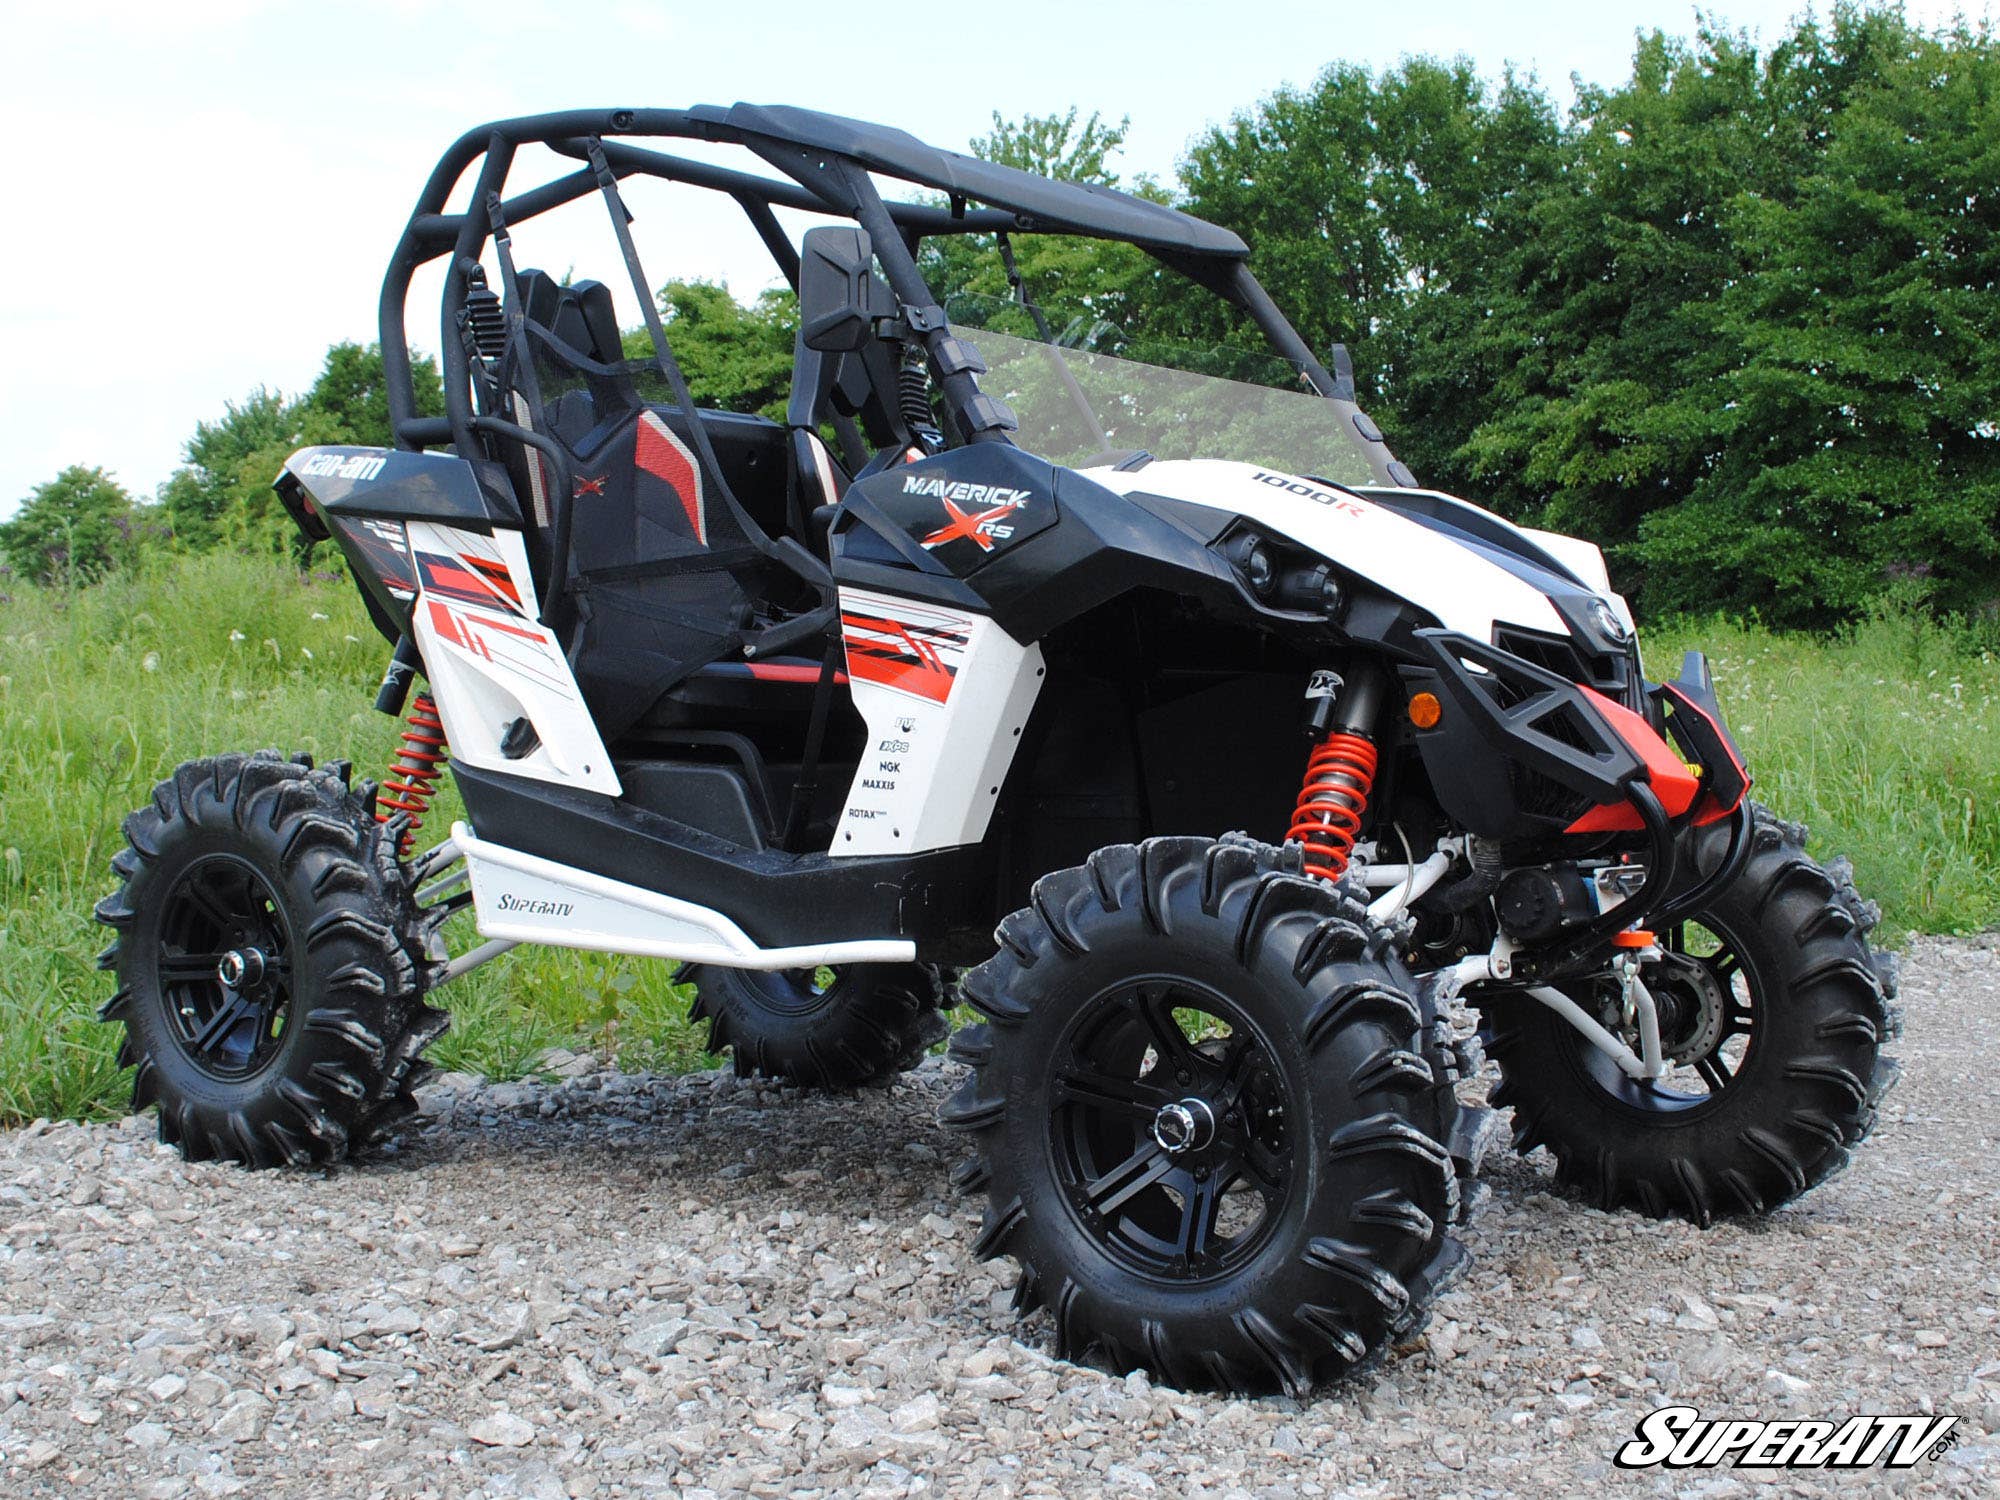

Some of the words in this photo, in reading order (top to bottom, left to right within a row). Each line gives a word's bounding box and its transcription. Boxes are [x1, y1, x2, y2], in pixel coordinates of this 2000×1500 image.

[301, 454, 387, 479] can-am
[903, 476, 1031, 508] MAVERICK
[1253, 473, 1368, 517] 1000R
[976, 523, 1014, 538] RS
[879, 761, 900, 773] NGK
[862, 779, 895, 790] MAXXIS
[849, 808, 875, 819] ROTAX
